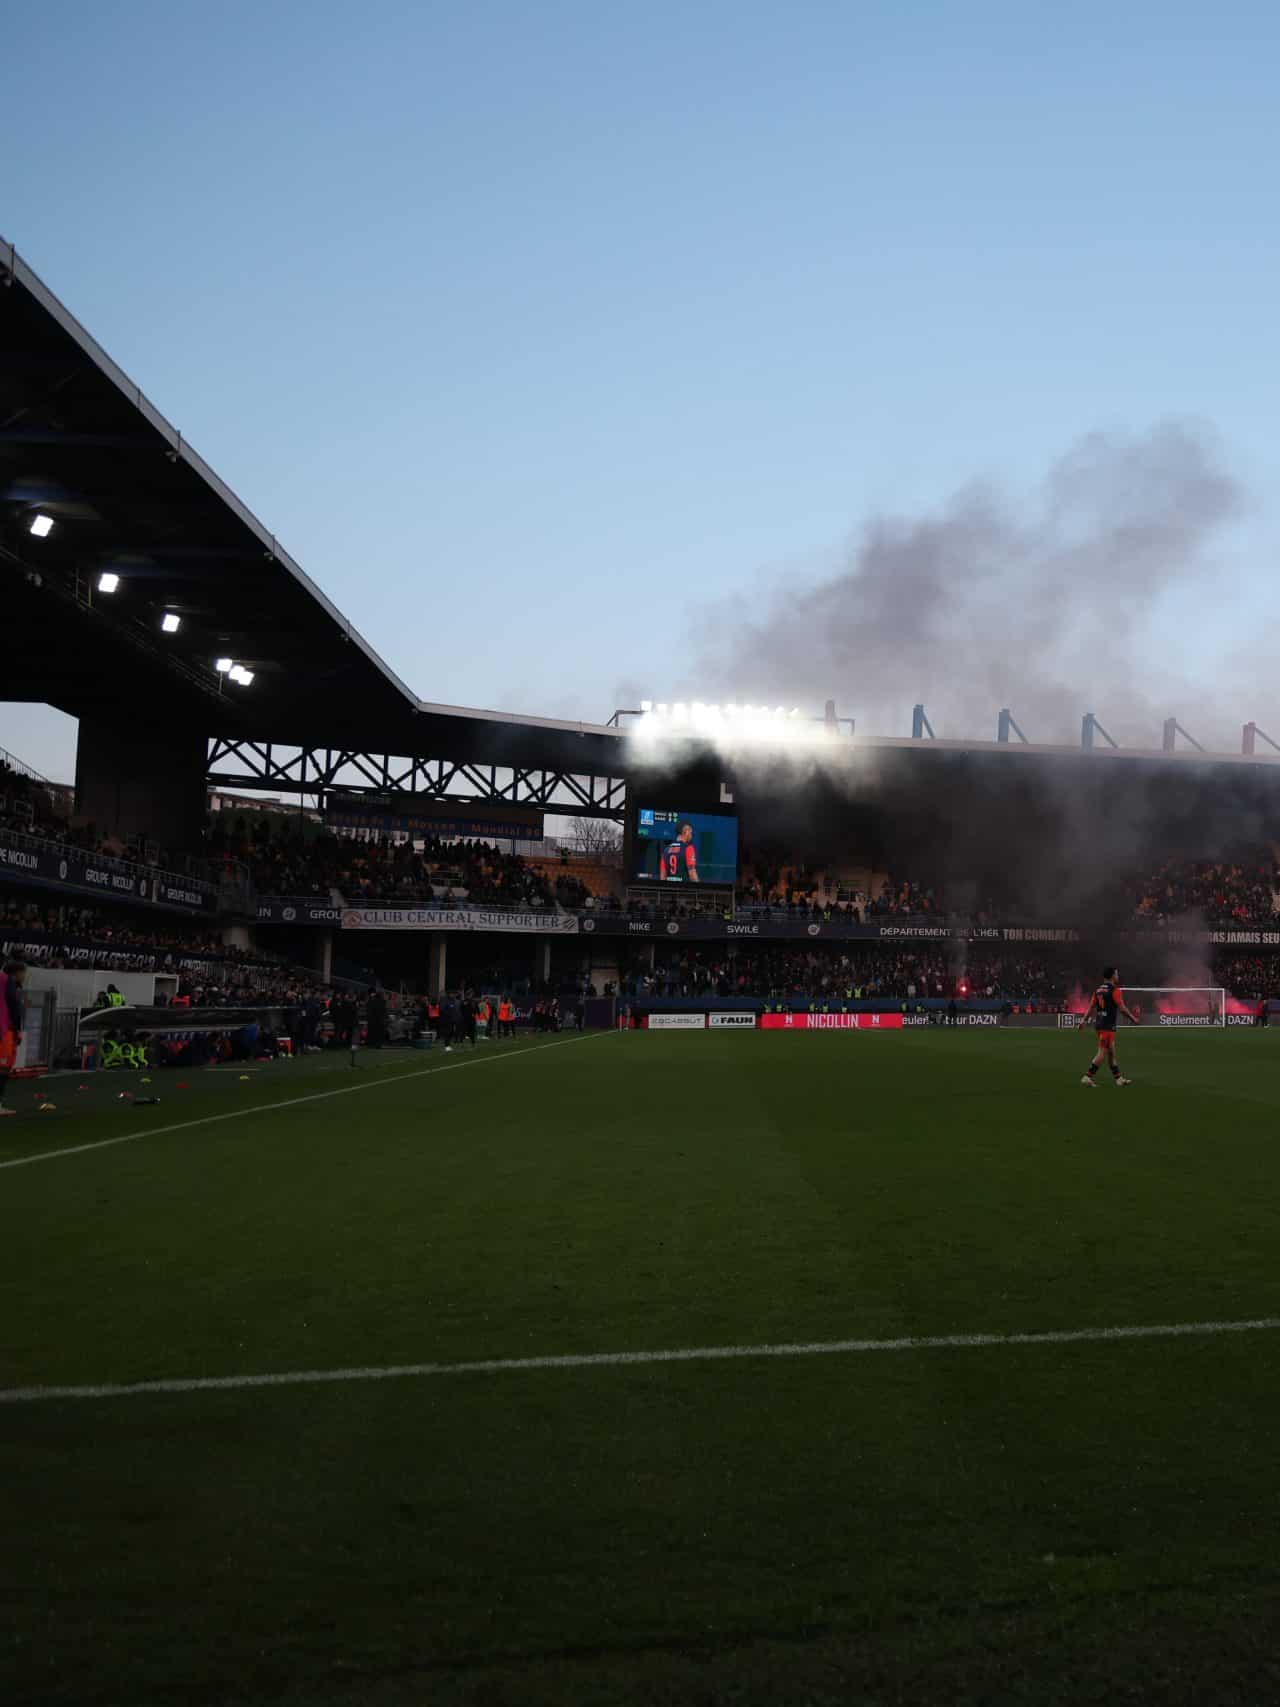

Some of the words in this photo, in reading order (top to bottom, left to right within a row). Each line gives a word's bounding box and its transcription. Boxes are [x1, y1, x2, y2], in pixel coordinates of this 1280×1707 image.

[364, 911, 402, 923] CLUB
[407, 911, 471, 924] CENTRAL
[629, 922, 651, 931] NIKE
[727, 925, 759, 934] SWILE
[880, 927, 951, 937] DEPARTEMENT
[1227, 931, 1261, 944] JAMAIS
[720, 1017, 753, 1025] FAUN
[807, 1013, 859, 1029] NICOLLIN
[969, 1014, 997, 1025] DAZN
[1160, 1014, 1210, 1026] Seulement
[1228, 1014, 1254, 1025] DAZN
